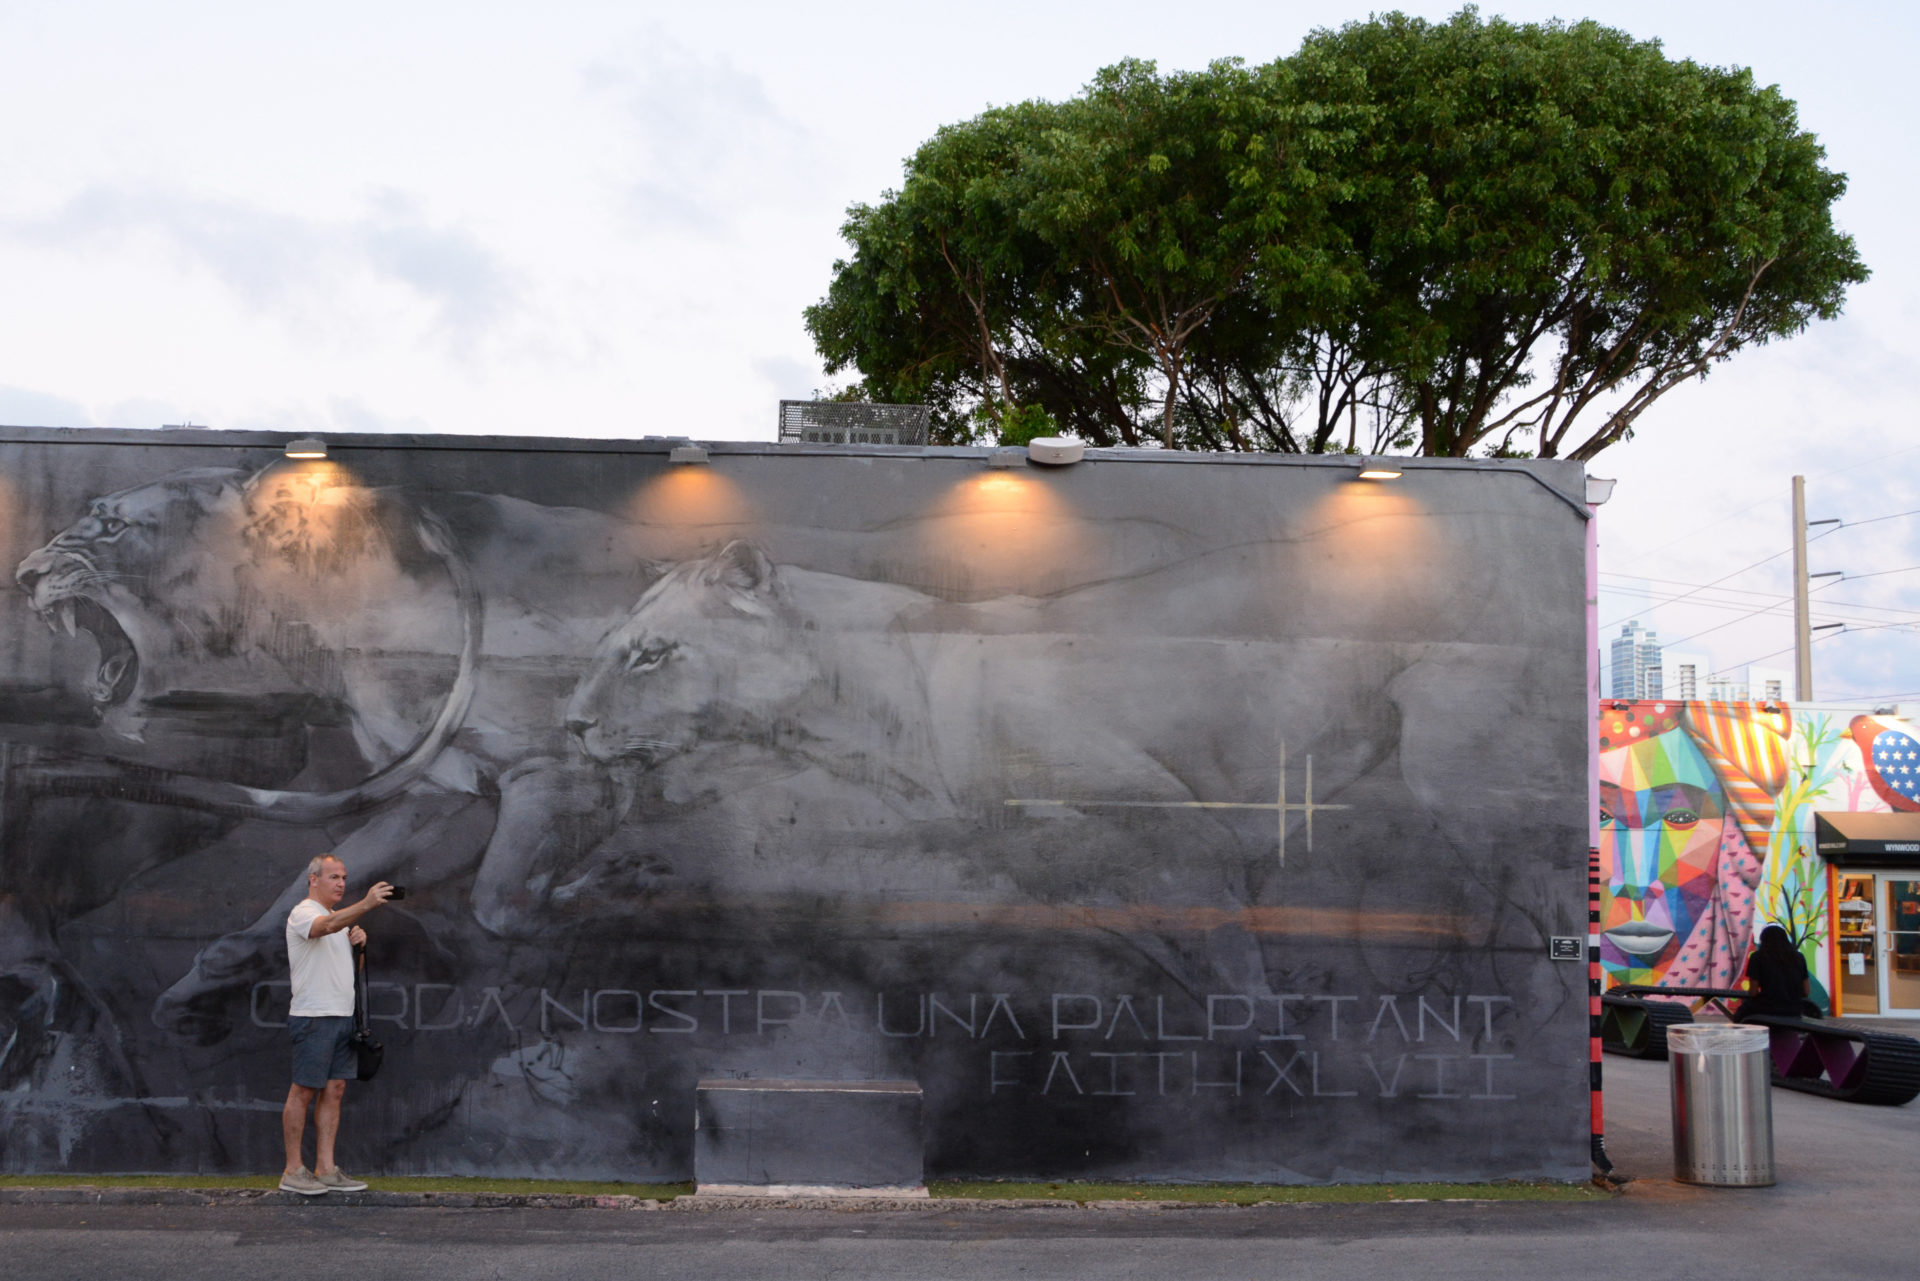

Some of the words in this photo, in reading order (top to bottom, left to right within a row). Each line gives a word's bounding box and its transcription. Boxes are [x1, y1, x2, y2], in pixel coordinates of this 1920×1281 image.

[1884, 843, 1920, 852] WYNWOOD
[250, 980, 516, 1031] CRDA
[876, 992, 1026, 1039] UNA
[1051, 993, 1513, 1043] PALPITANT
